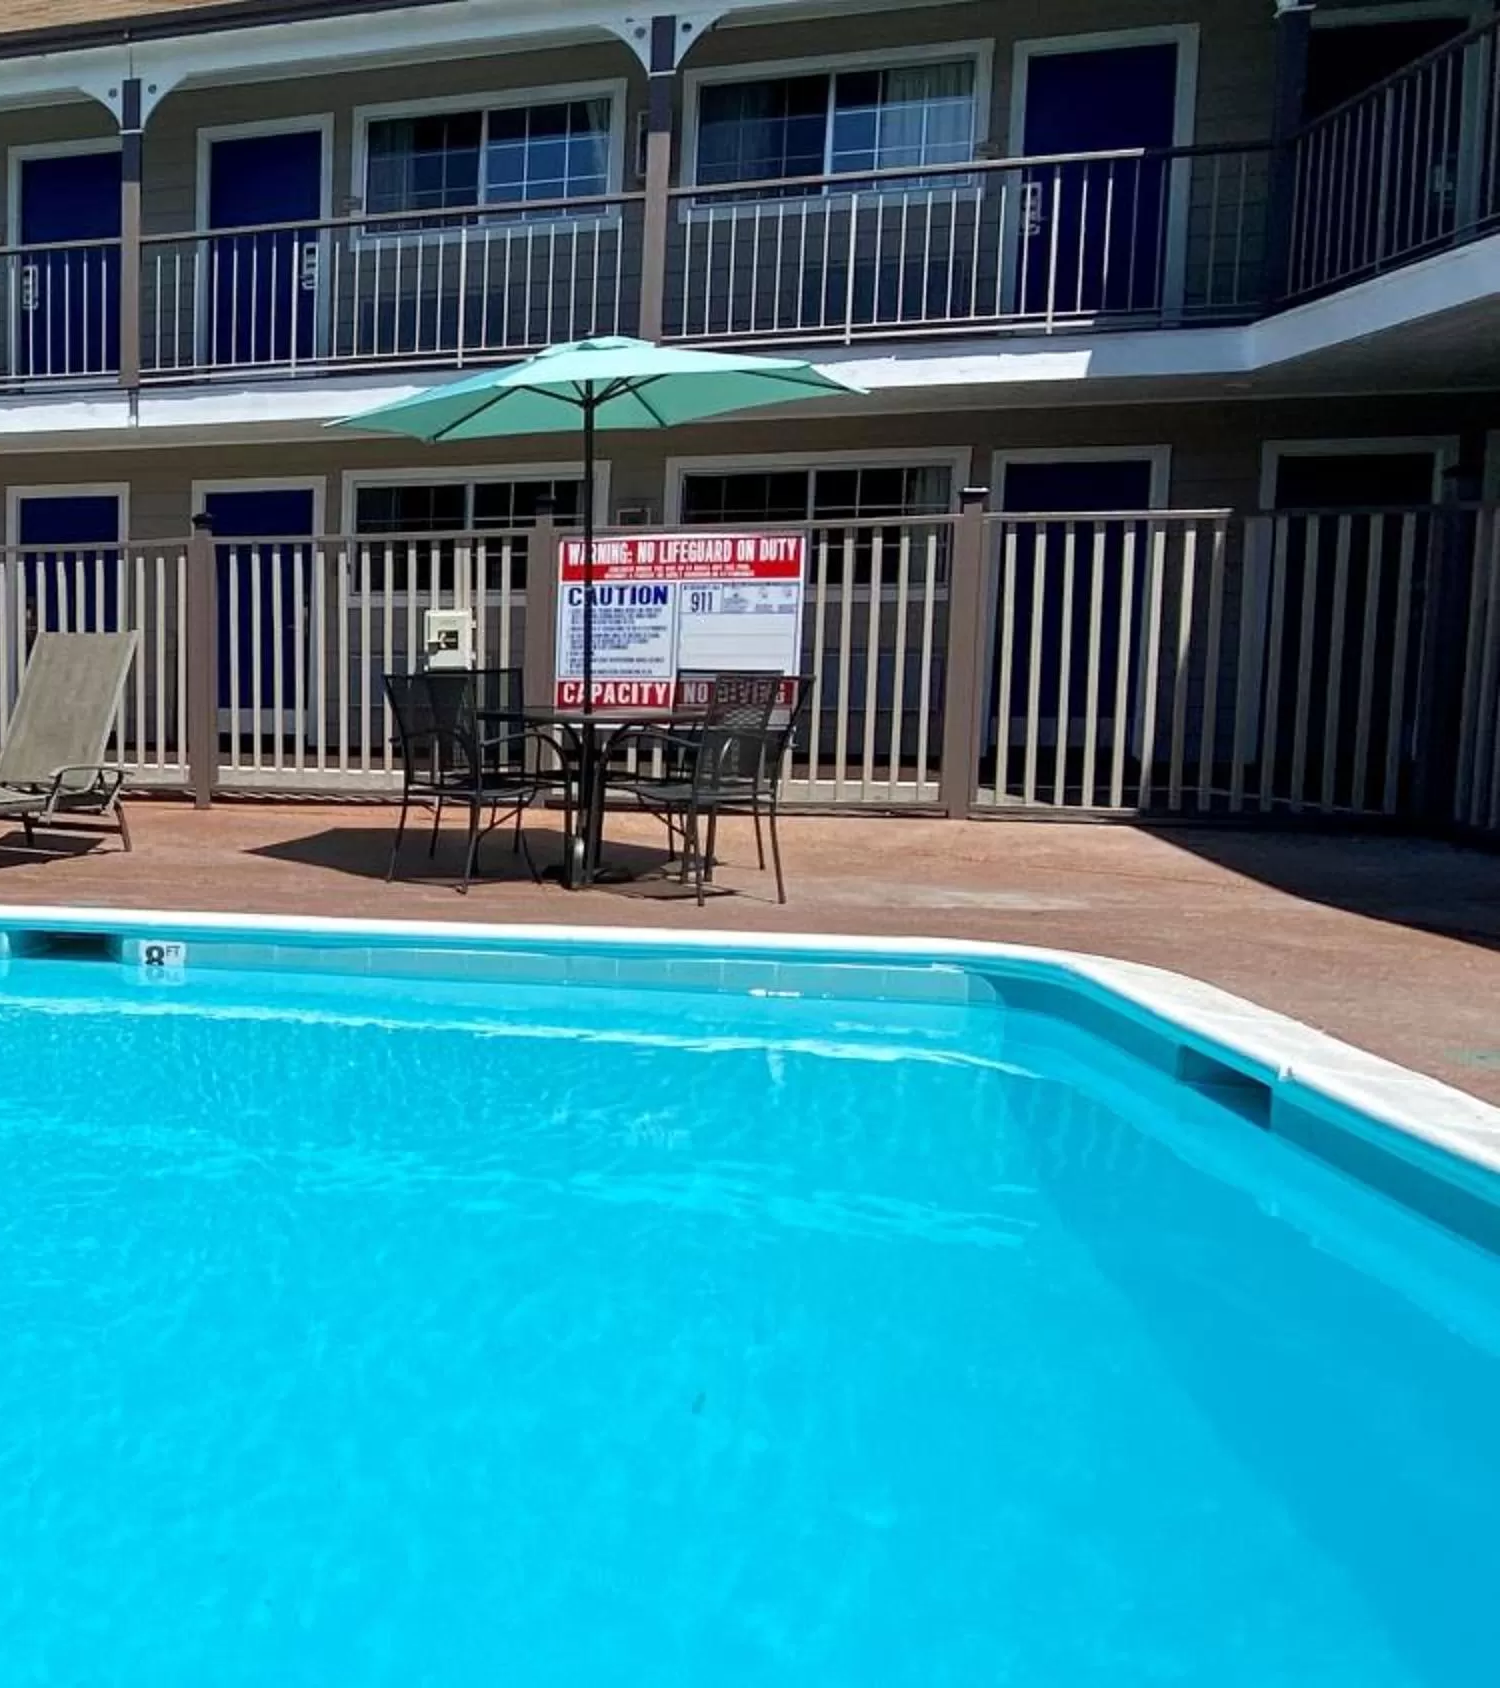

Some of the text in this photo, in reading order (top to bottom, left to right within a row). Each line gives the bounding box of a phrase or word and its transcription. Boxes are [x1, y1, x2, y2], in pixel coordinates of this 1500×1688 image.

[638, 541, 655, 563] NO
[660, 539, 733, 563] LIFEGUARD
[737, 539, 755, 562] ON
[759, 537, 797, 561] DUTY
[691, 592, 713, 612] 911
[683, 682, 709, 703] NO
